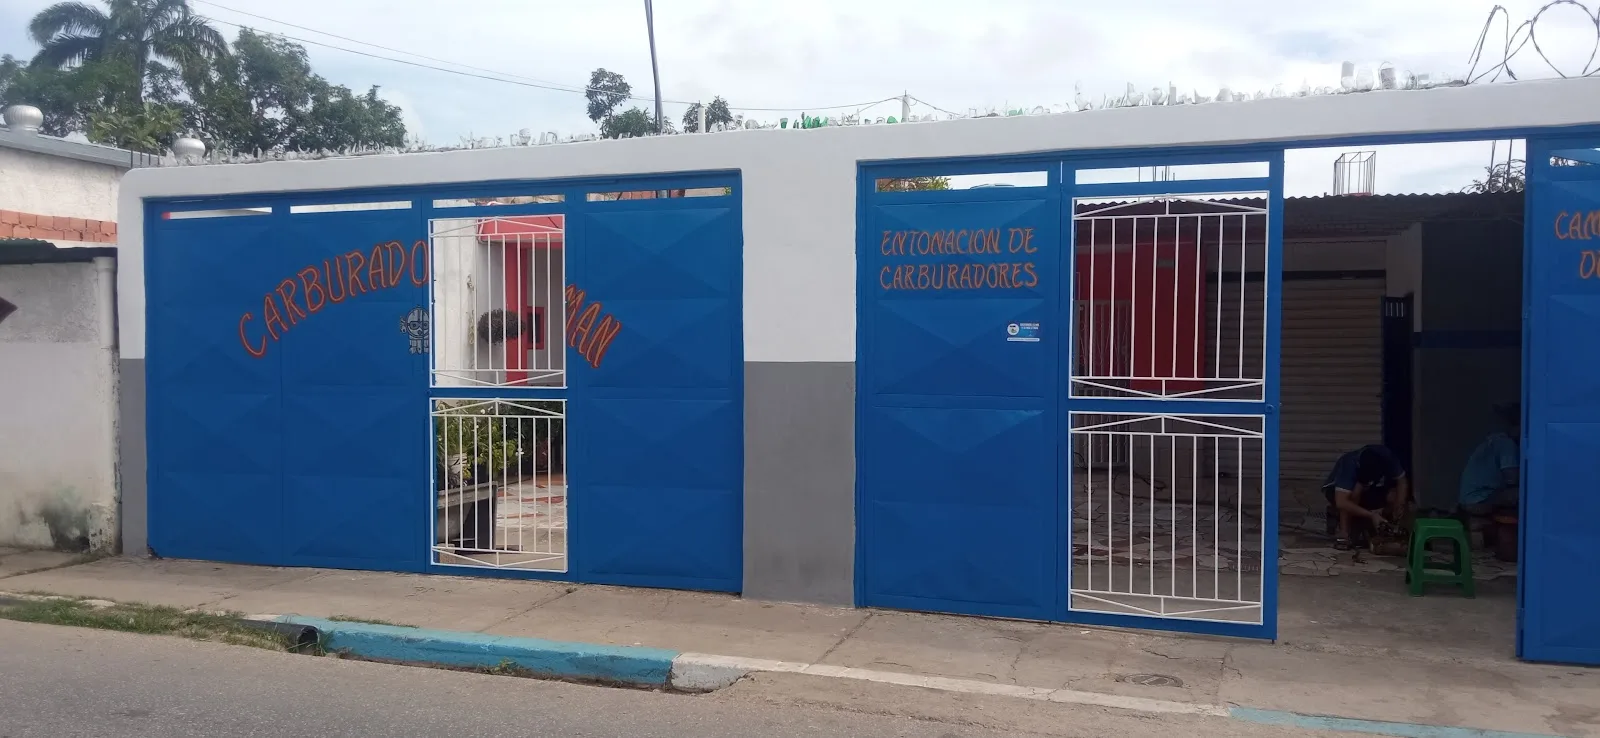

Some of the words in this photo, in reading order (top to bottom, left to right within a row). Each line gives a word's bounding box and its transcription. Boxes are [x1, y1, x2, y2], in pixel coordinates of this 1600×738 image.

[880, 228, 1001, 256] ENTONACION
[1008, 227, 1038, 254] DE
[880, 262, 1039, 290] CARBURADORES
[238, 239, 429, 358] CARBURADO
[565, 283, 621, 368] MAN
